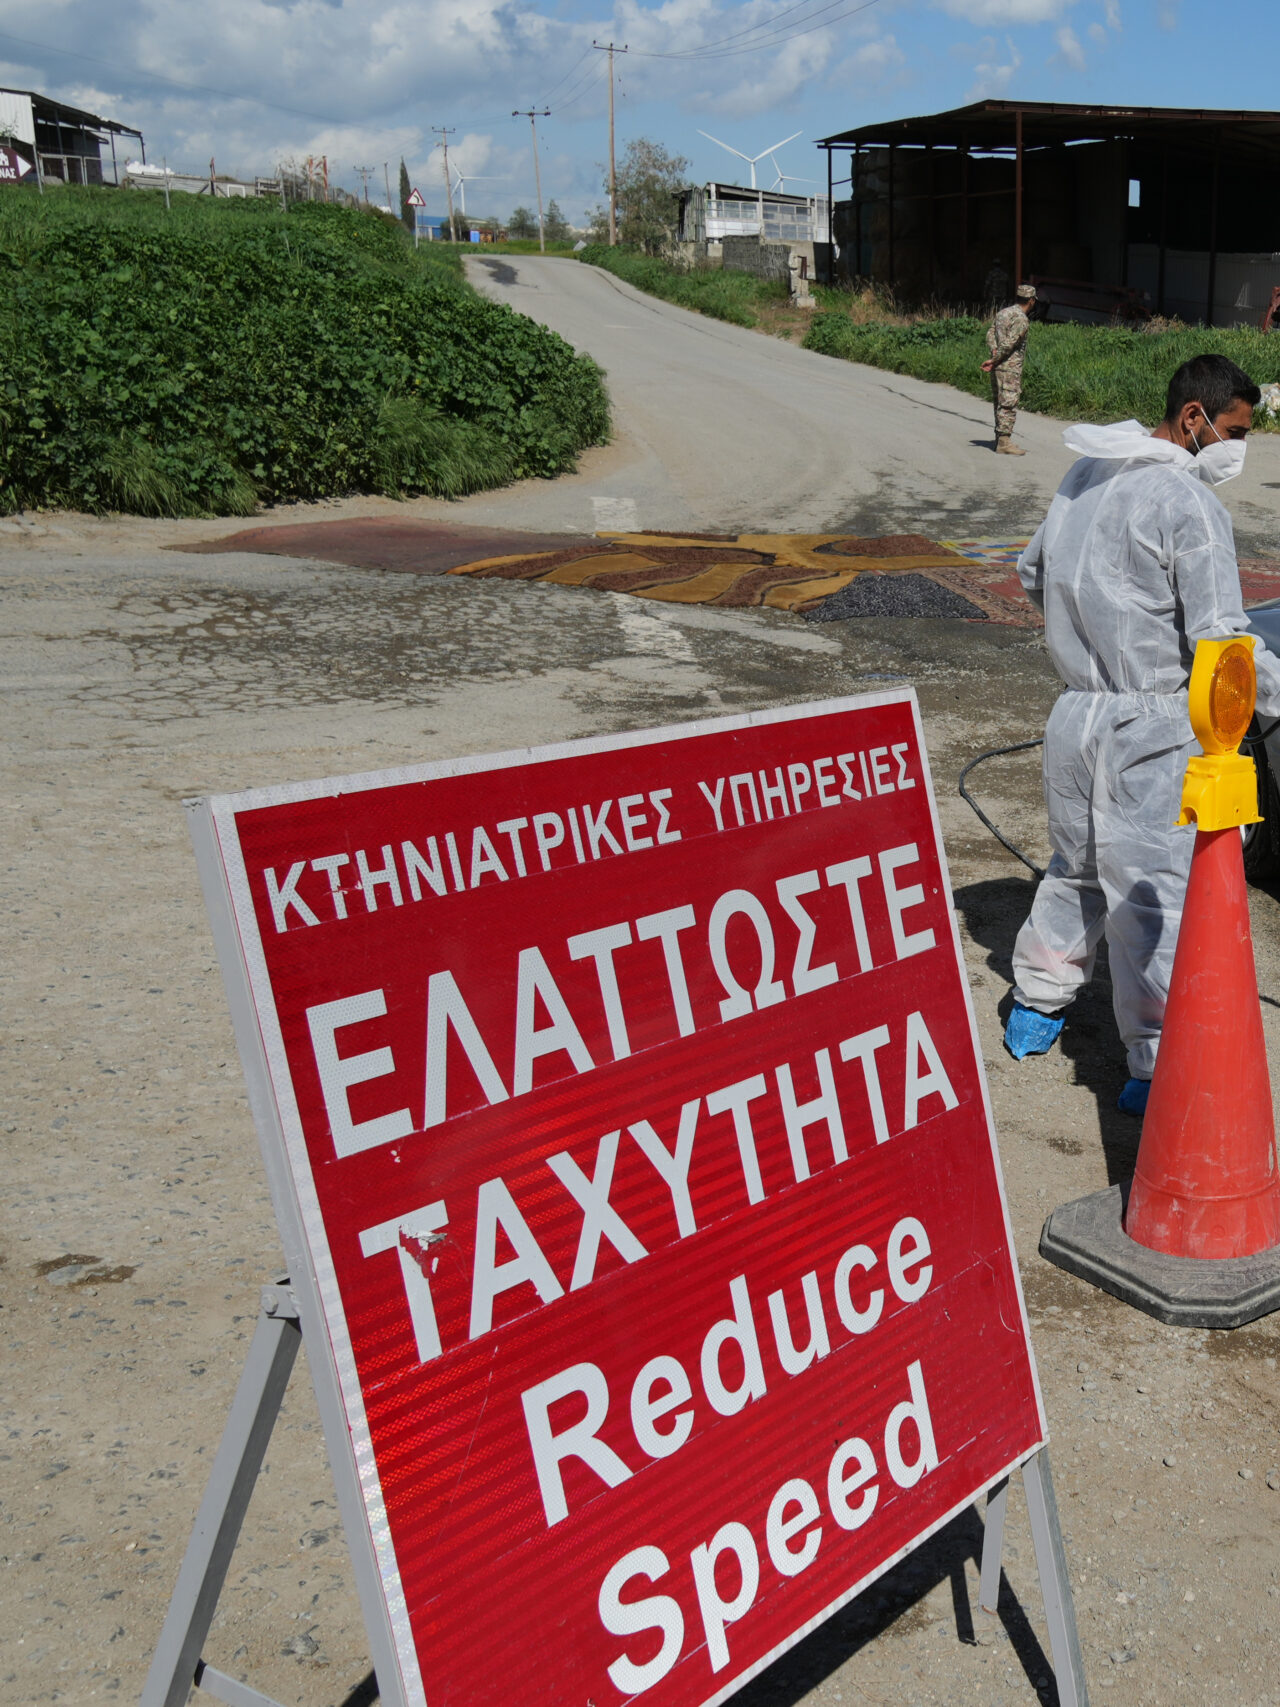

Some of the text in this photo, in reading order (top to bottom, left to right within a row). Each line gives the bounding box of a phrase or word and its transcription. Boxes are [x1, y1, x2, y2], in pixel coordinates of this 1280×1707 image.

[264, 742, 916, 933] ΚΤΗΝΙΑΤΡΙΚΕΣ ΥΠΗΡΕΣΙΕΣ
[305, 842, 937, 1160] ΕΛΑΤΤΩΣΤΕ
[358, 1010, 960, 1365] ΤΑΧΥΤΗΤΑ
[520, 1216, 933, 1528] Reduce
[598, 1359, 940, 1695] Speed
